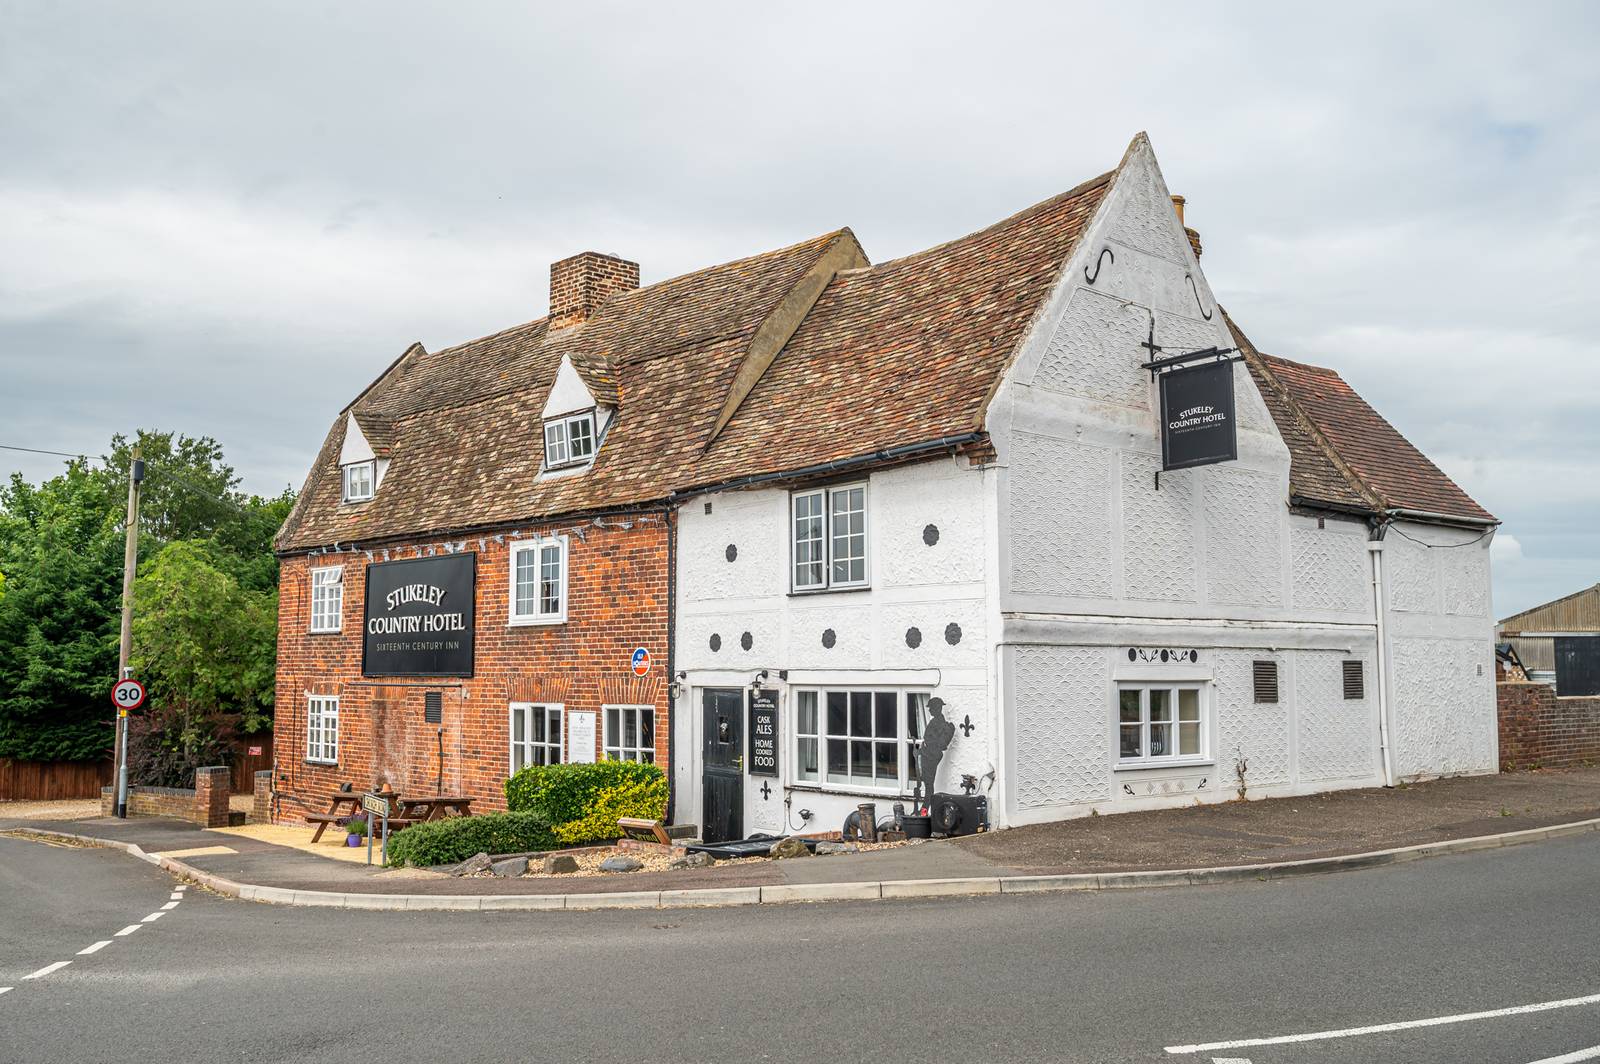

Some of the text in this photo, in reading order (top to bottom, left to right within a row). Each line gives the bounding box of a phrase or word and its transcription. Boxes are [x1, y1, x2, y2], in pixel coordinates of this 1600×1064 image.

[1179, 405, 1214, 420] STUKELEY
[1169, 412, 1226, 429] COUNTRY HOTEL
[386, 584, 445, 611] STUKELEY
[368, 613, 466, 635] COUNTRY HOTEL
[376, 641, 460, 652] SIXTEENTH CENTURY INN
[117, 688, 140, 701] 30
[757, 715, 771, 724] CASK
[755, 724, 773, 735] ALES
[754, 739, 774, 749] HOME
[755, 748, 773, 756] COOKED
[754, 756, 775, 767] FOOD
